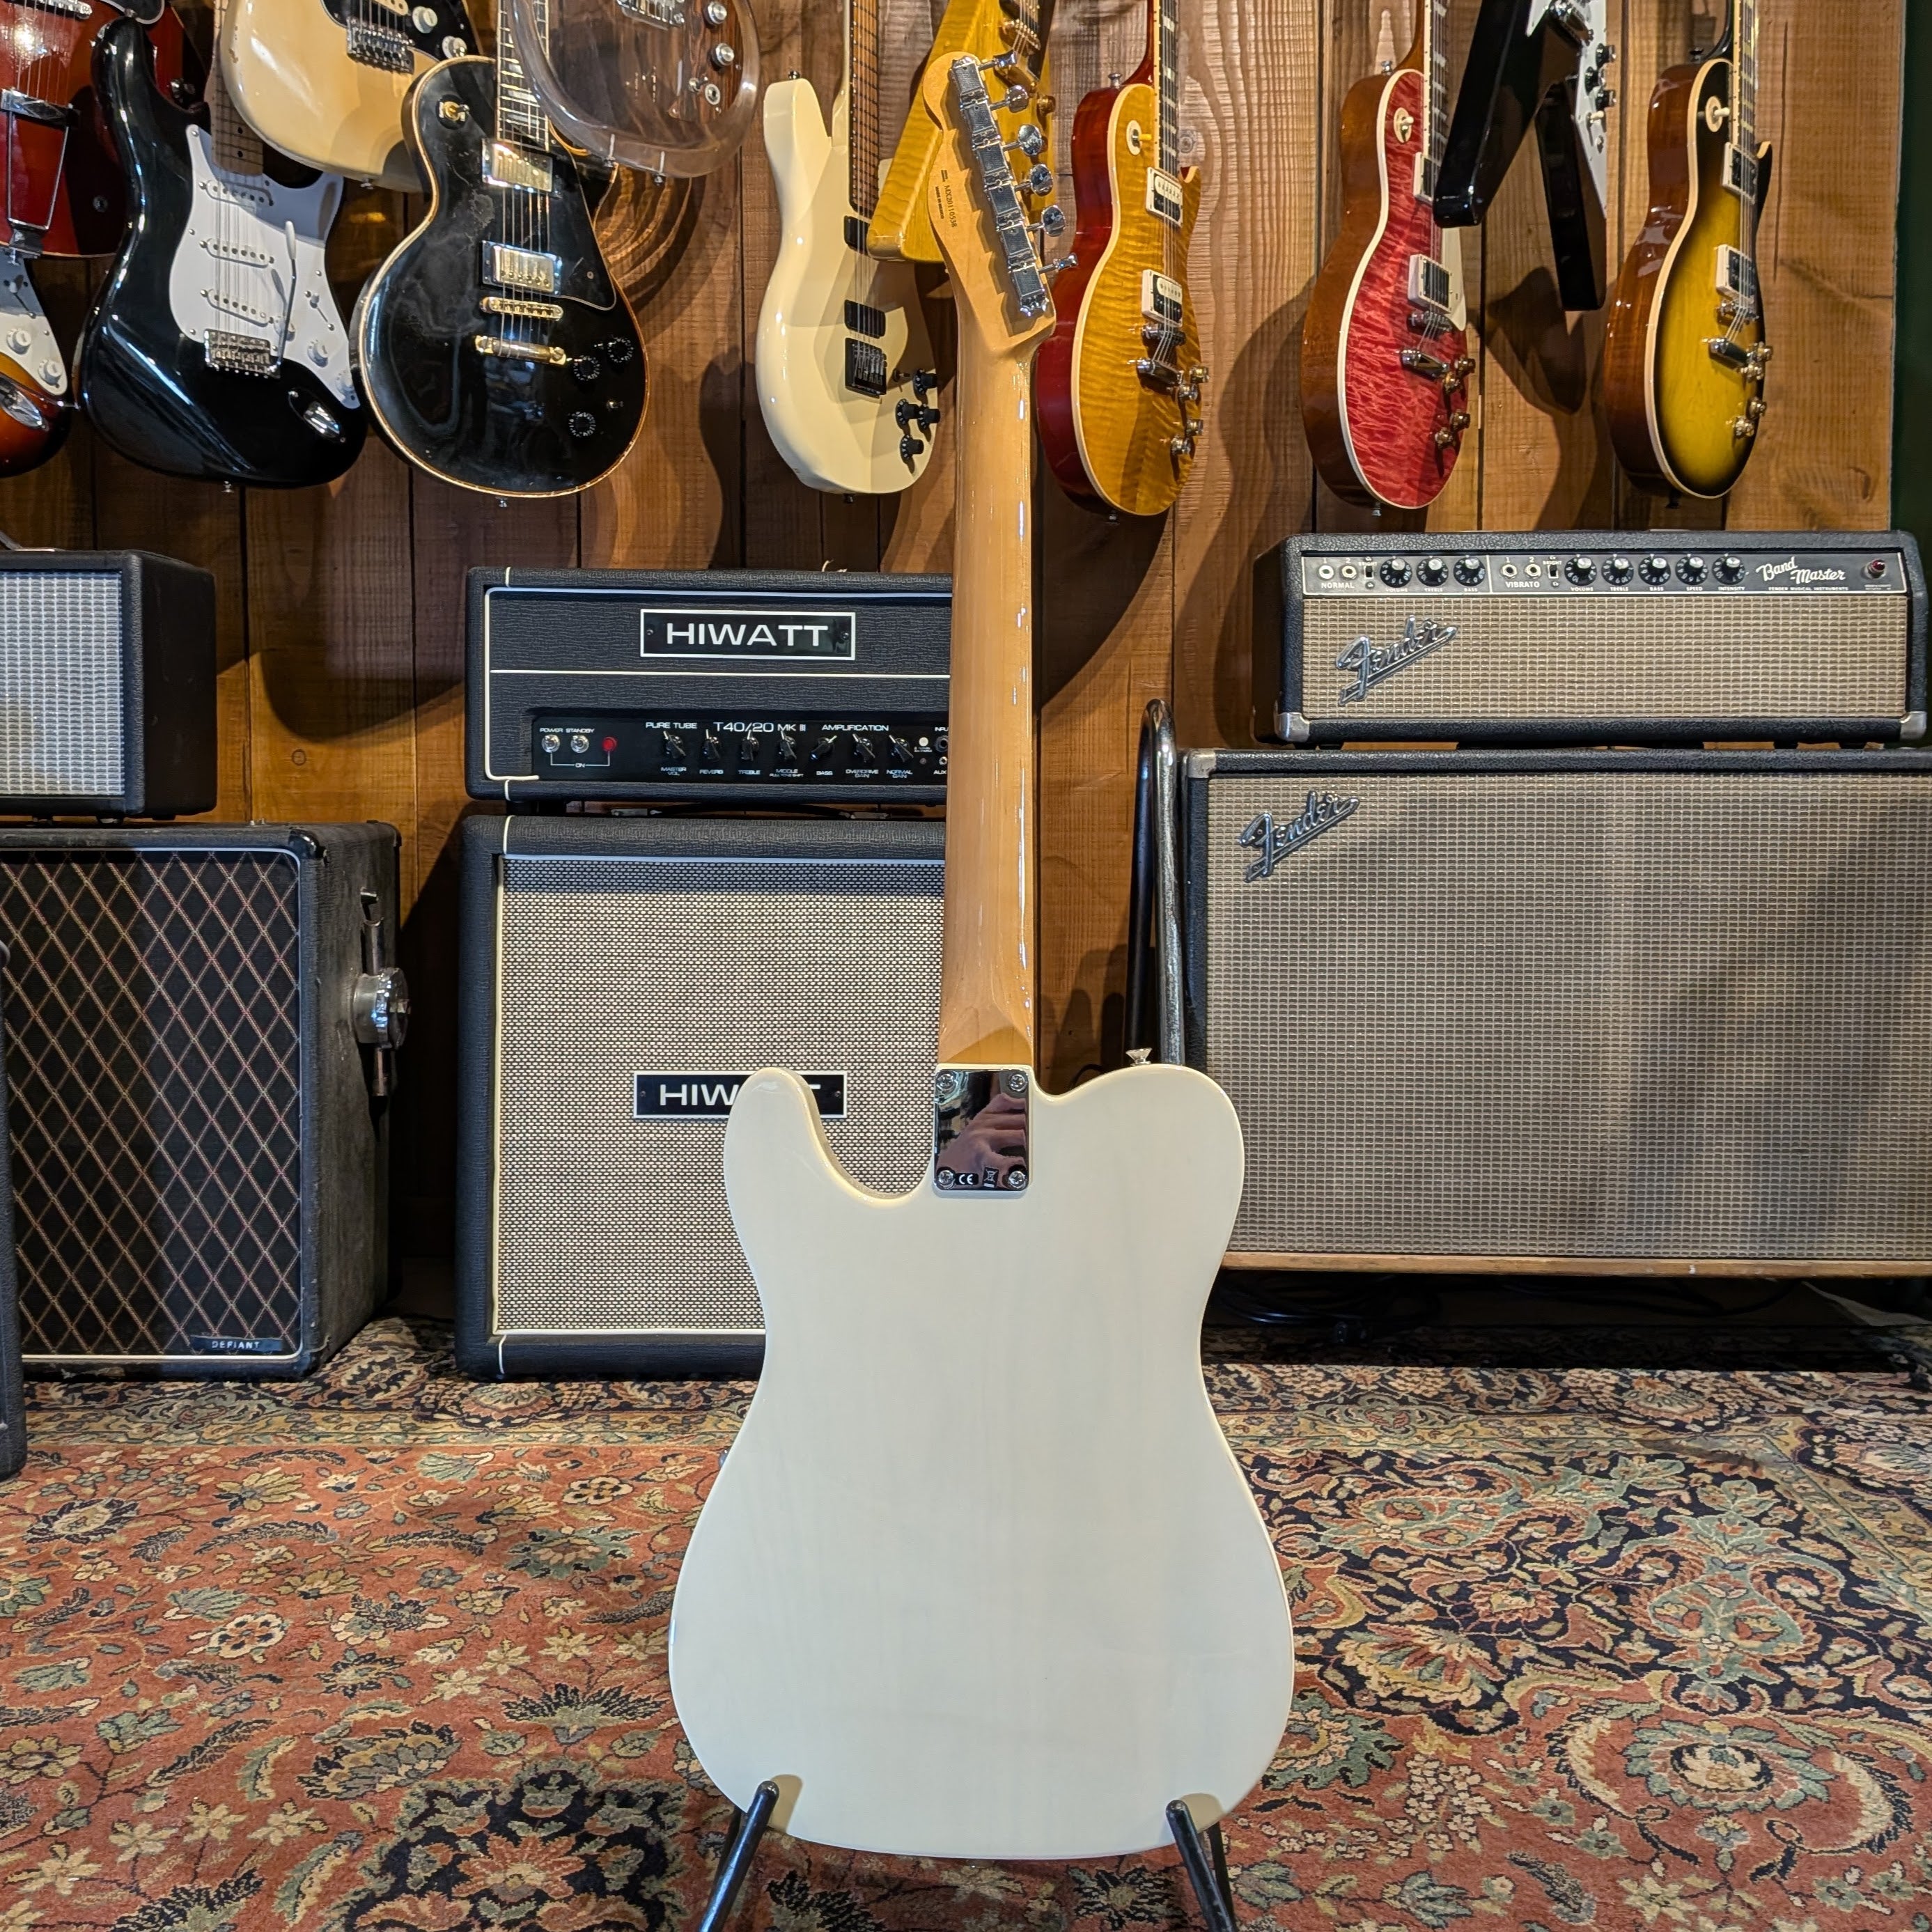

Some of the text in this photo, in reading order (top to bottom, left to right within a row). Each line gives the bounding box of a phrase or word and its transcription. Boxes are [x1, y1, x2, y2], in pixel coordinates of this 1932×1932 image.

[1756, 556, 1798, 582] Band
[667, 623, 829, 646] HIWATT
[1336, 615, 1458, 706] Fender
[713, 722, 774, 732] T40/20
[1238, 790, 1360, 883] Fender
[211, 1341, 260, 1350] DEFIANT
